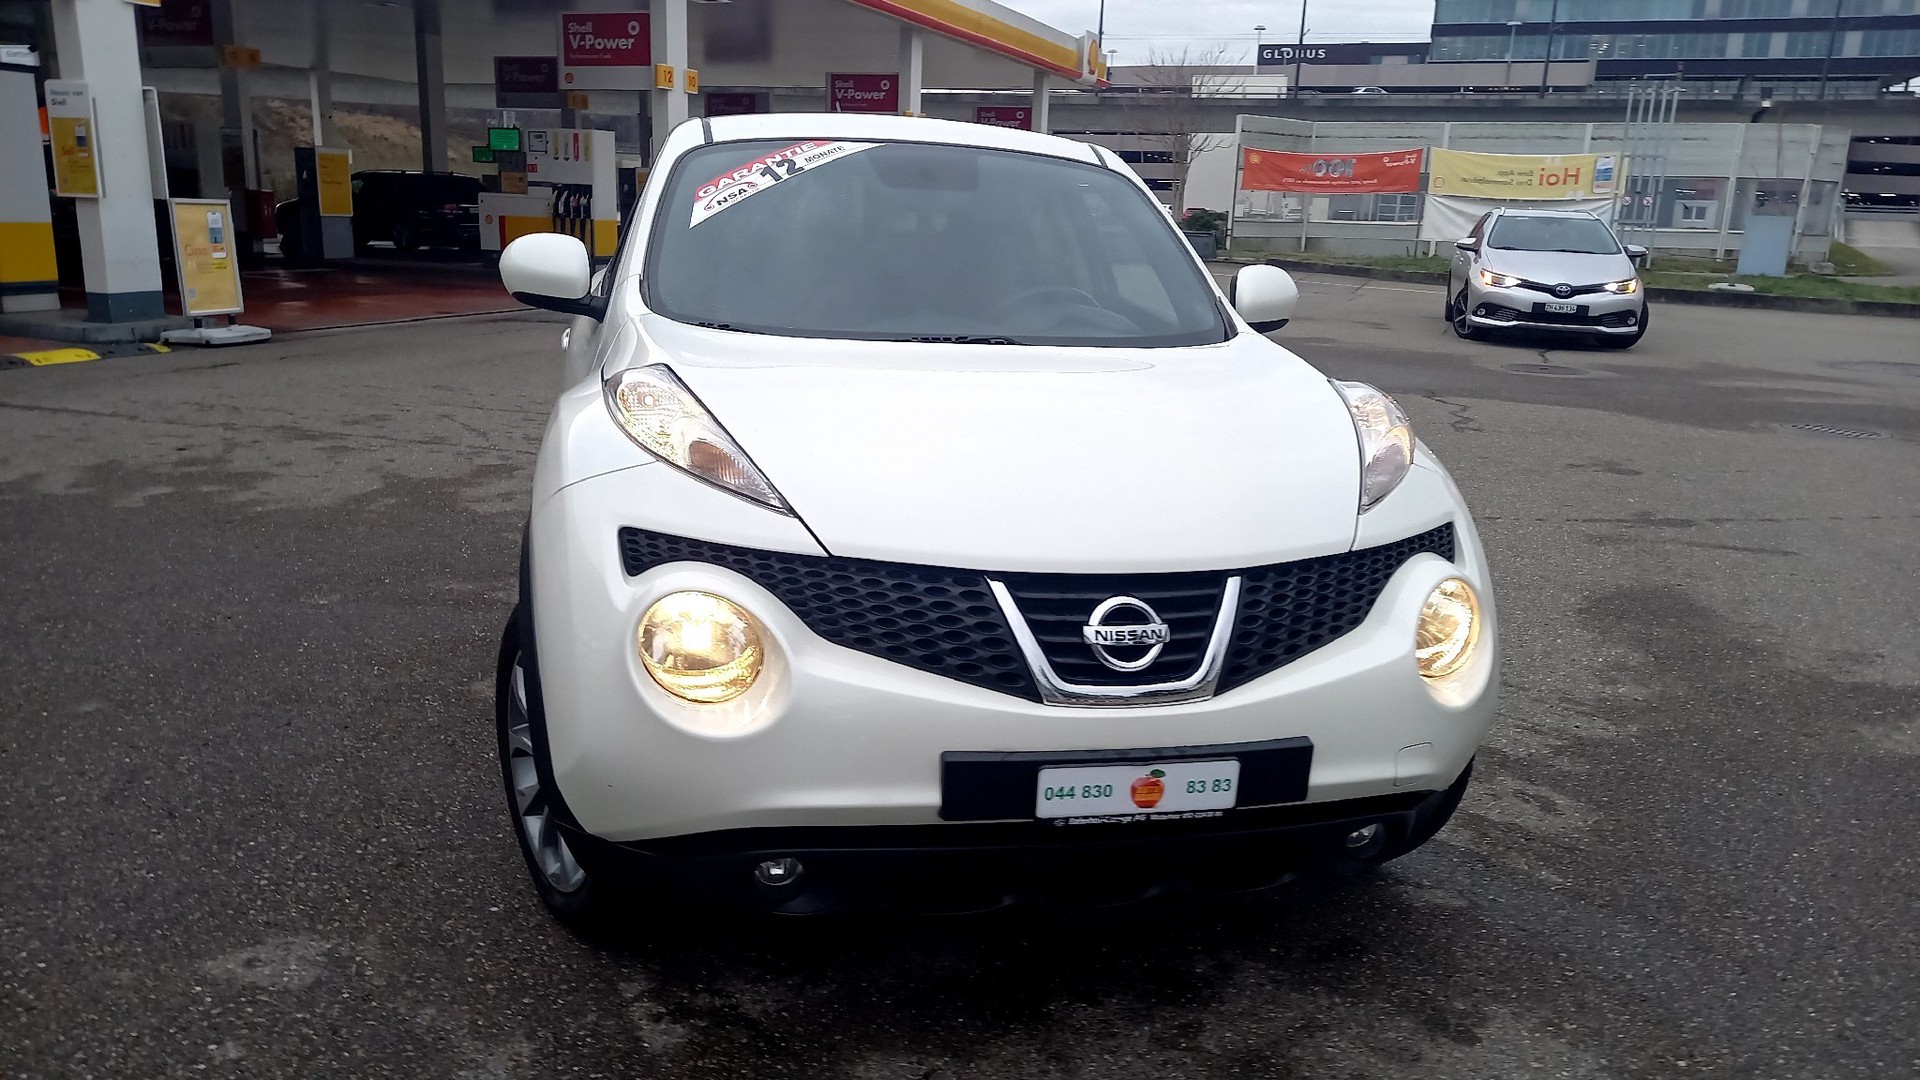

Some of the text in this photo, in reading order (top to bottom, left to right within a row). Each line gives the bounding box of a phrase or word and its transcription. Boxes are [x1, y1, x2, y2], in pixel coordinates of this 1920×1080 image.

[568, 22, 592, 33] Shell
[568, 34, 635, 50] V-Power
[663, 70, 673, 83] 12
[834, 79, 854, 88] Shell
[835, 88, 886, 100] V-Power
[697, 142, 817, 199] GARANTIE
[760, 145, 846, 183] 12 MONATE
[716, 187, 748, 206] NSA
[1094, 628, 1163, 642] NISSAN
[1044, 778, 1232, 801] 044 830 83 83
